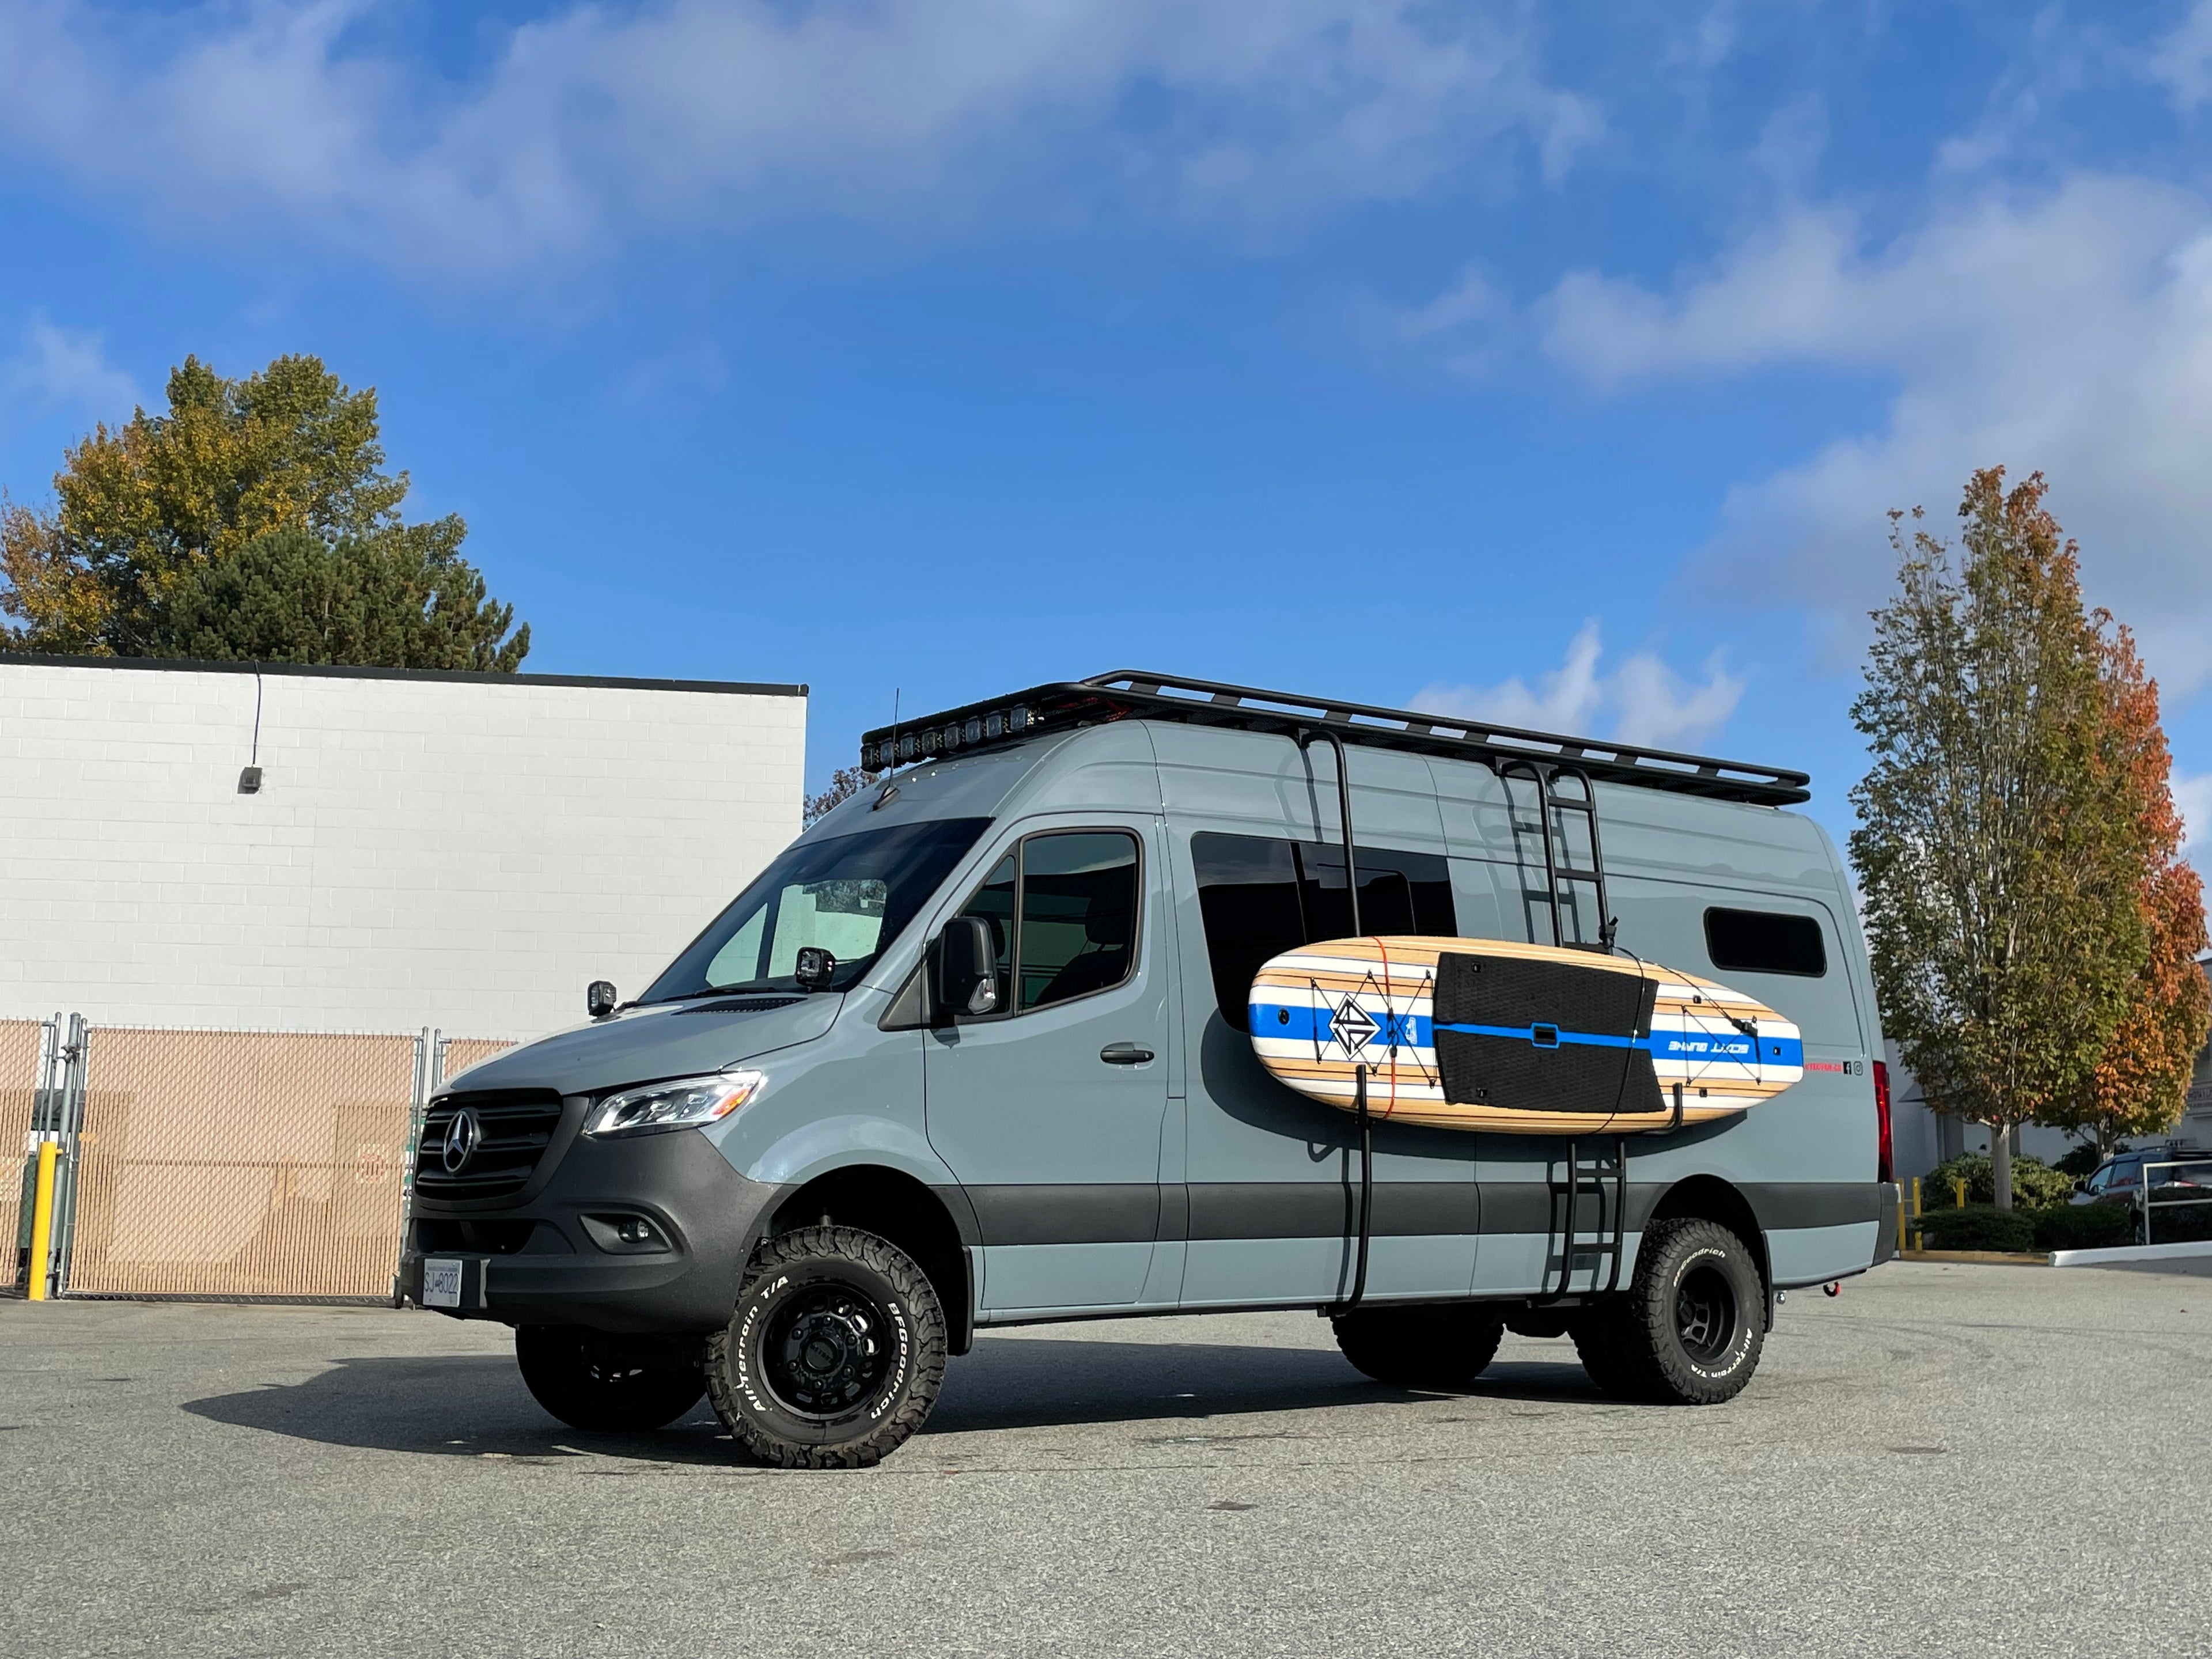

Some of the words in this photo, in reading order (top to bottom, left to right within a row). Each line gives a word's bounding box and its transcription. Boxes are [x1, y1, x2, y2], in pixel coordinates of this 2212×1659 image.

[733, 1305, 767, 1411] All-Terrain
[760, 1275, 789, 1300] T/A
[870, 1302, 908, 1419] BFGoodrich
